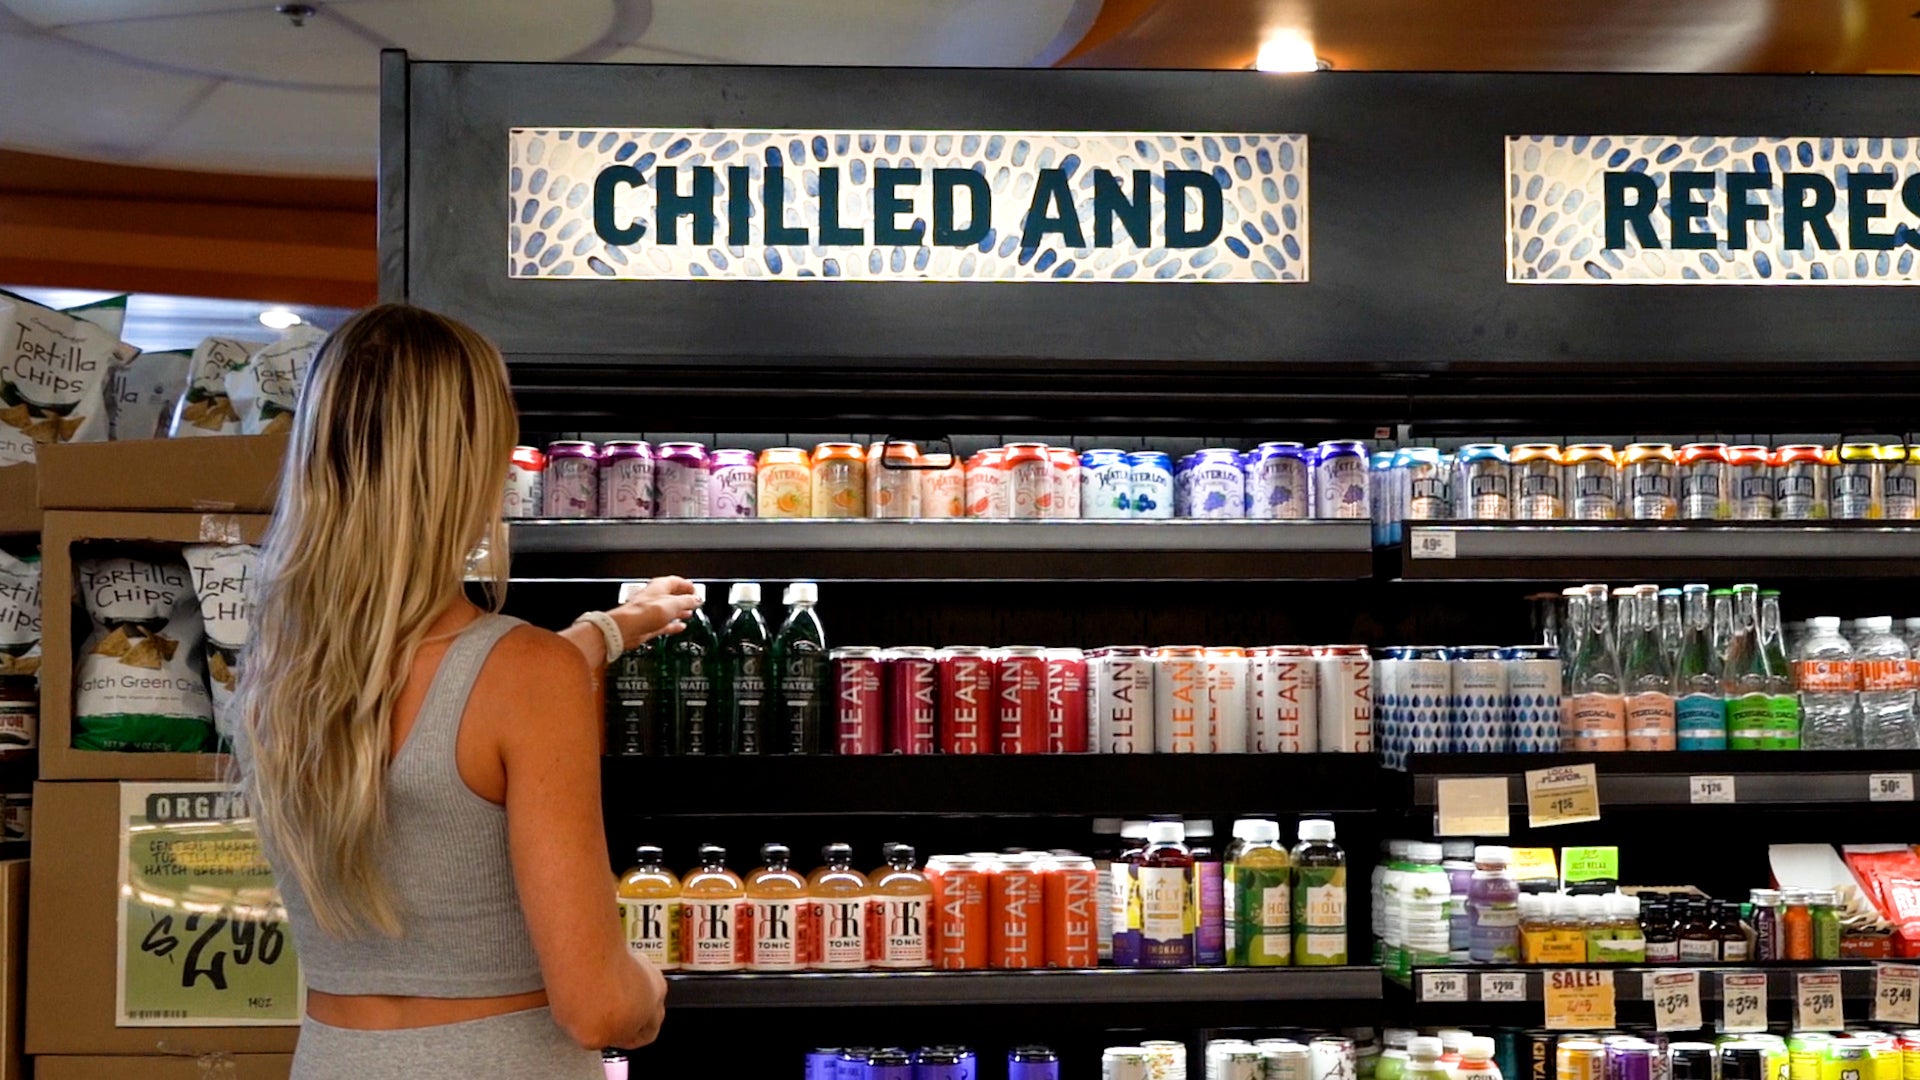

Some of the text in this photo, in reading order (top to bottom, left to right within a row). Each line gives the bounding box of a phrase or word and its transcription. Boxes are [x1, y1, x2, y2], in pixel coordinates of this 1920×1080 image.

[593, 165, 1224, 249] CHILLED AND
[121, 675, 171, 690] Green
[841, 661, 862, 755] CLEAN
[915, 663, 934, 755] CLEAN
[955, 661, 977, 755] CLEAN
[1002, 662, 1021, 755] CLEAN
[1112, 663, 1133, 752] CLEAN
[1172, 662, 1194, 752] CLEAN
[1278, 662, 1299, 752] CLEAN
[1354, 662, 1371, 752] CLEAN
[1542, 773, 1581, 784] FLAVOR
[1547, 768, 1574, 777] LOCAL
[144, 865, 188, 876] HATCH
[630, 940, 663, 950] TONIC
[698, 940, 730, 950] TONIC
[759, 940, 790, 950] TONIC
[829, 939, 861, 949] TONIC
[890, 938, 922, 948] TONIC
[943, 875, 965, 969] CLEAN
[1005, 875, 1027, 968] CLEAN
[1066, 875, 1089, 968] CLEAN
[1551, 971, 1601, 990] SALE!
